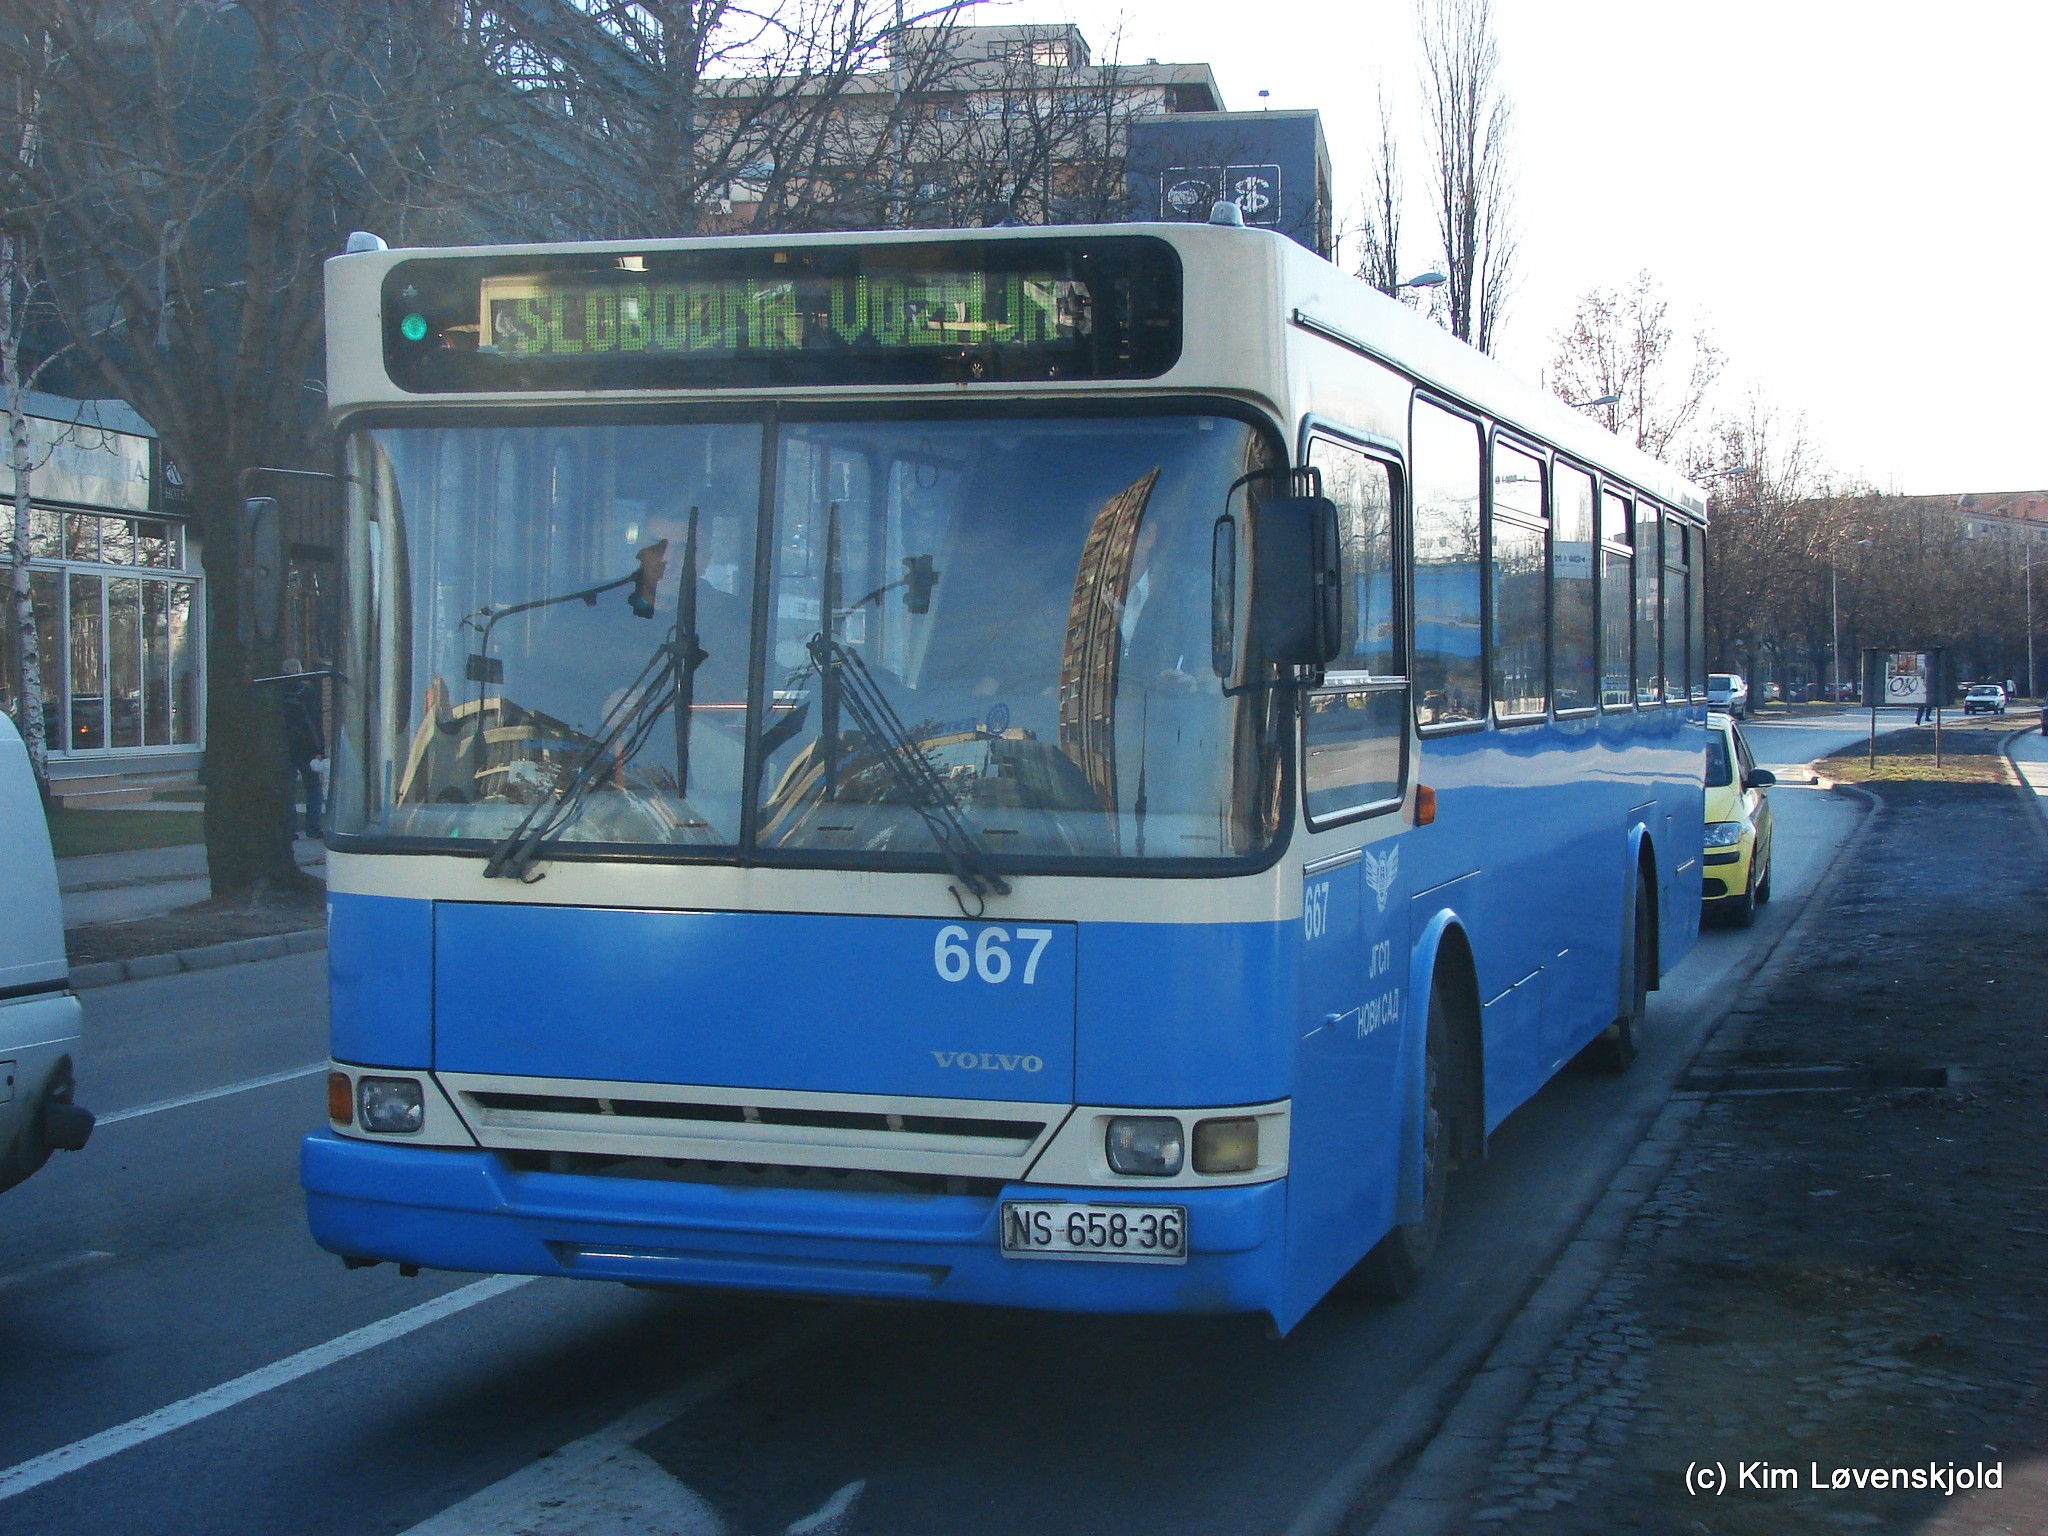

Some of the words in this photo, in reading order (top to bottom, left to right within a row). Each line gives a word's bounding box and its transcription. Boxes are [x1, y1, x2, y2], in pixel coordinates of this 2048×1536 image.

[1304, 881, 1330, 941] 667
[933, 925, 1053, 985] 667
[1357, 997, 1381, 1040] НОВИ
[1381, 988, 1399, 1027] САД
[931, 1050, 1044, 1073] VOLVO
